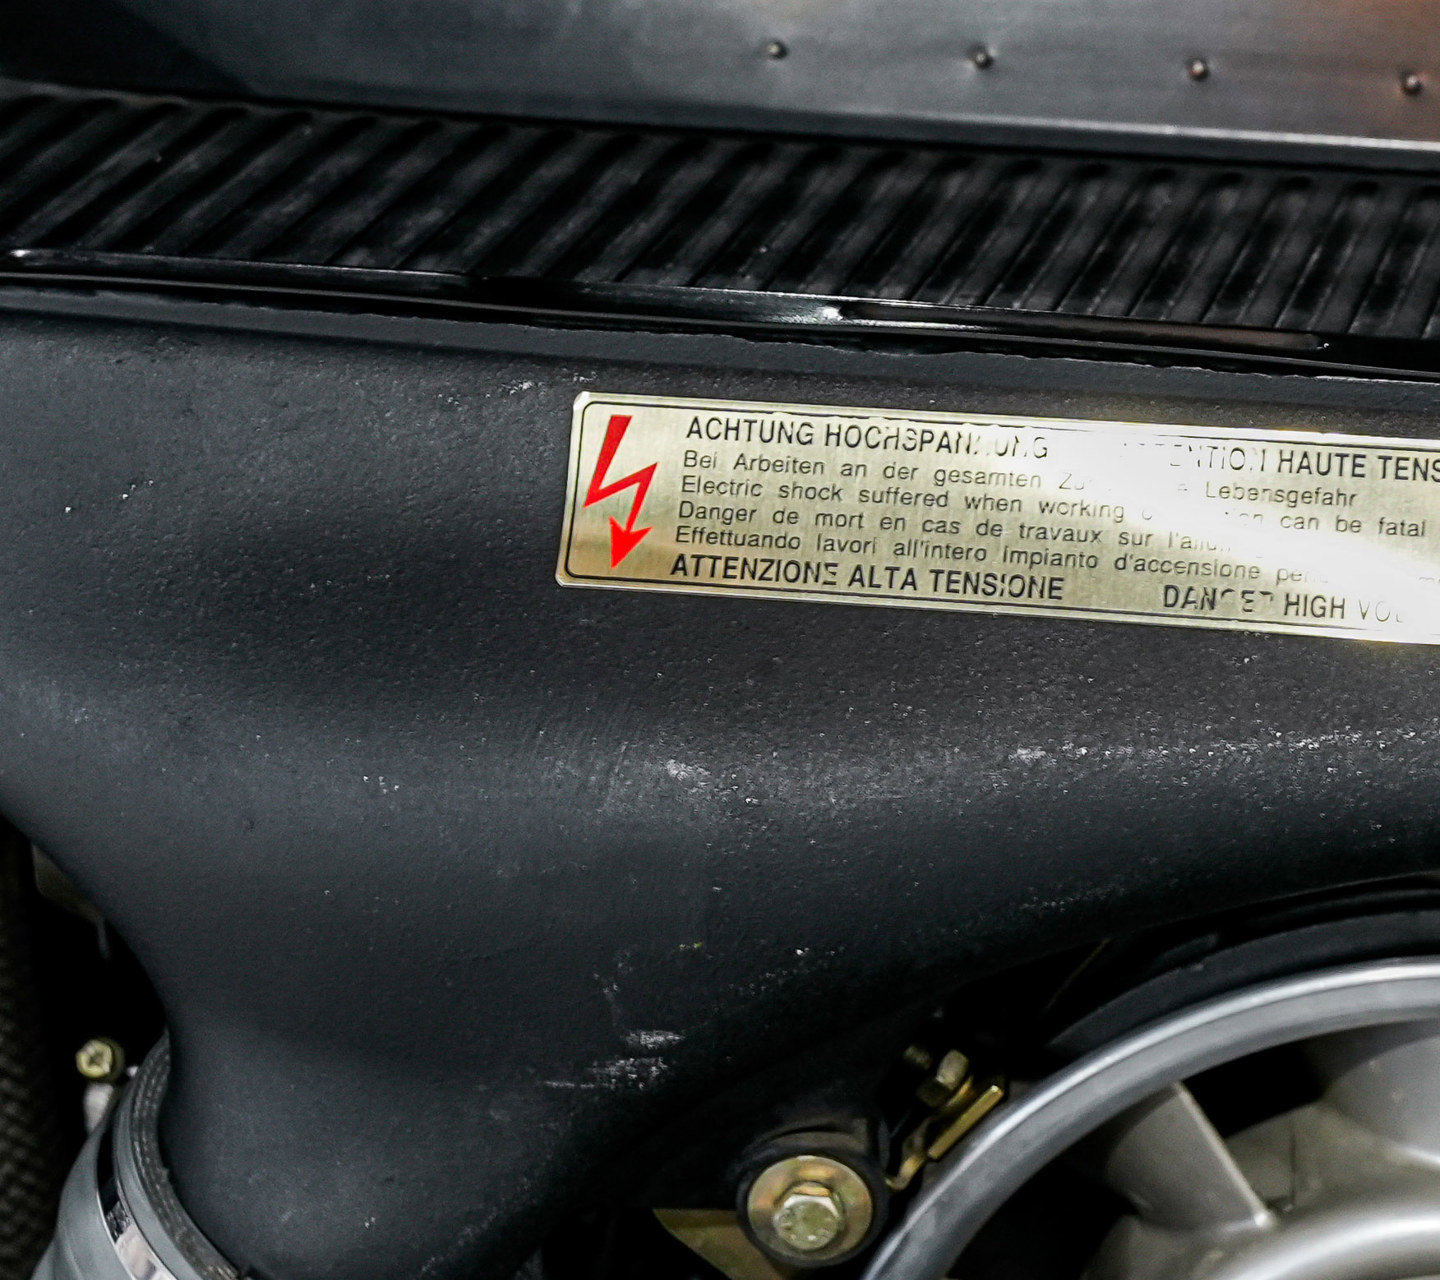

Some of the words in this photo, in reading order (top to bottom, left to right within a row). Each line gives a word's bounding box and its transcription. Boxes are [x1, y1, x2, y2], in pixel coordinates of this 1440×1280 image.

[686, 416, 814, 446] ACHTUNG
[683, 450, 717, 469] Bei
[733, 452, 824, 475] Arbeiten
[840, 462, 867, 477] an
[883, 461, 919, 480] der
[933, 467, 1042, 489] gesamten
[1206, 481, 1358, 508] Lebensgefahr
[1277, 449, 1366, 478] HAUTE
[678, 500, 757, 526] Danger
[772, 507, 800, 525] de
[814, 511, 864, 529] mort
[880, 516, 906, 531] en
[921, 519, 961, 535] cas
[975, 518, 1003, 538] de
[1018, 521, 1104, 544] travaux
[1118, 531, 1153, 548] sur
[681, 474, 763, 497] Electric
[778, 480, 844, 503] shock
[860, 485, 950, 508] suffered
[964, 493, 1022, 513] when
[1039, 500, 1125, 523] working
[1280, 512, 1319, 531] can
[1335, 514, 1362, 534] be
[1378, 517, 1427, 538] fatal
[670, 553, 839, 586] ATTENZIONE
[847, 563, 918, 592] ALTA
[929, 569, 1064, 601] TENSIONE
[675, 525, 801, 551] Effettuando
[817, 533, 877, 555] lavori
[893, 538, 987, 563] all'intero
[1002, 545, 1099, 570] impianto
[1114, 552, 1261, 581] d'accensione
[1283, 592, 1346, 621] HIGH
